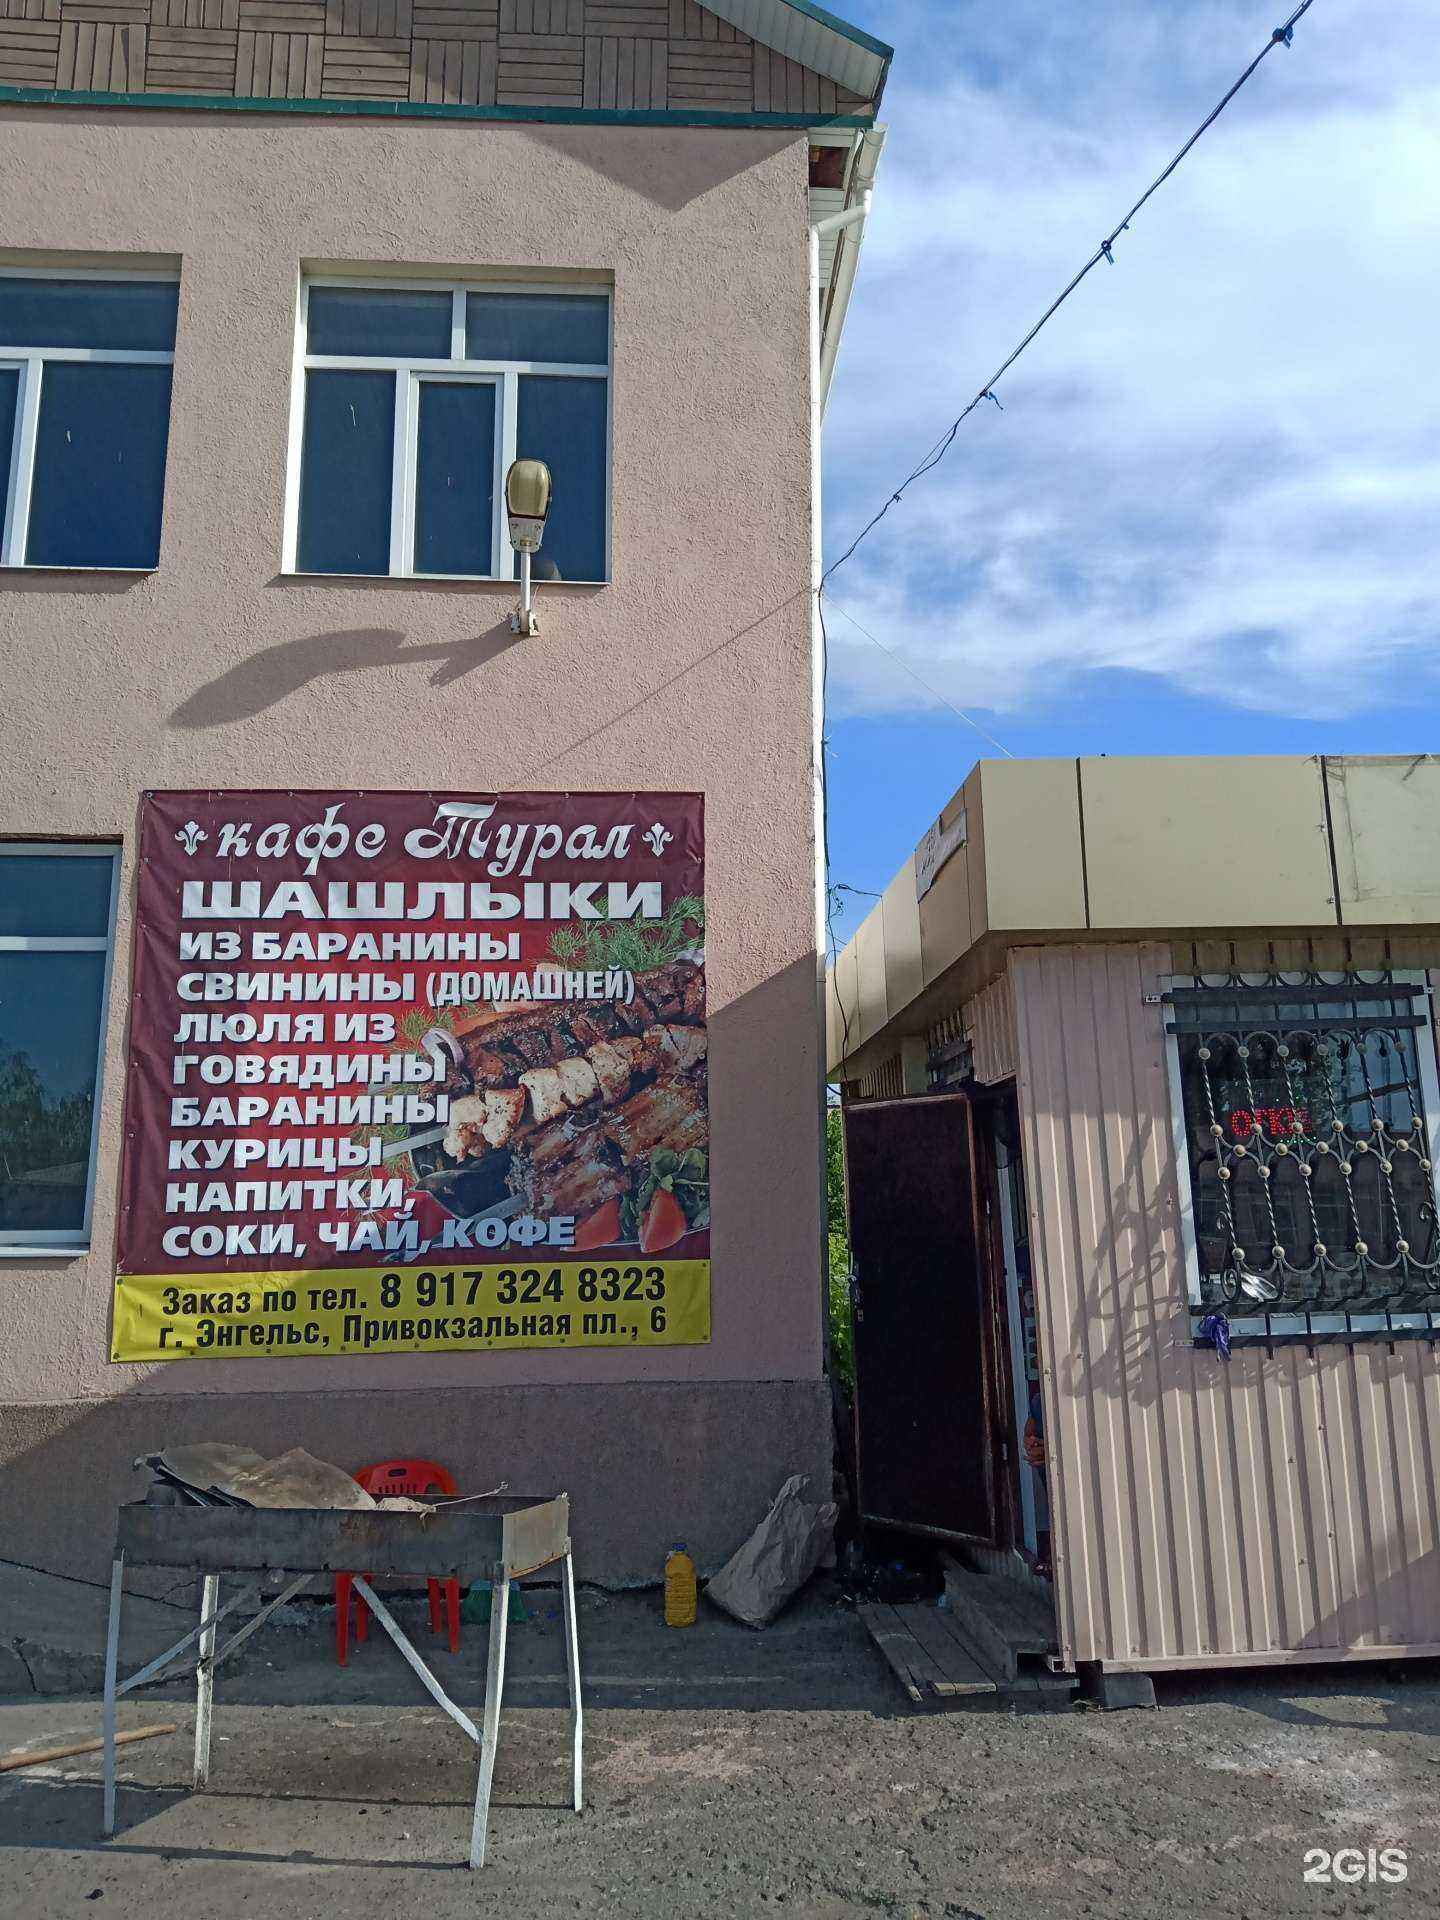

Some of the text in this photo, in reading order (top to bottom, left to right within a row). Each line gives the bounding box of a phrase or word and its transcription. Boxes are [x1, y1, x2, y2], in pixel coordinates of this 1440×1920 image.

[217, 801, 635, 876] кафе Турал
[181, 881, 662, 920] ШАШЛЫКИ
[180, 933, 520, 961] ИЗ БАРАНИНЫ
[176, 965, 635, 1006] СВИНИНЫ (ДОМАШНЕЙ)
[173, 1013, 395, 1043] ЛЮЛЯ ИЗ
[173, 1053, 446, 1090] ГОВЯДИНЫ
[170, 1095, 448, 1127] БАРАНИНЫ
[167, 1137, 382, 1171] КУРИЦЫ
[165, 1179, 415, 1214] НАПИТКИ,
[162, 1212, 575, 1259] СОКИ, ЧАЙ, КОФЕ
[162, 1267, 665, 1316] Заказ по тел. 8 917 324 8323
[158, 1306, 666, 1349] г. Энгельс, Привокзальная пл., 6
